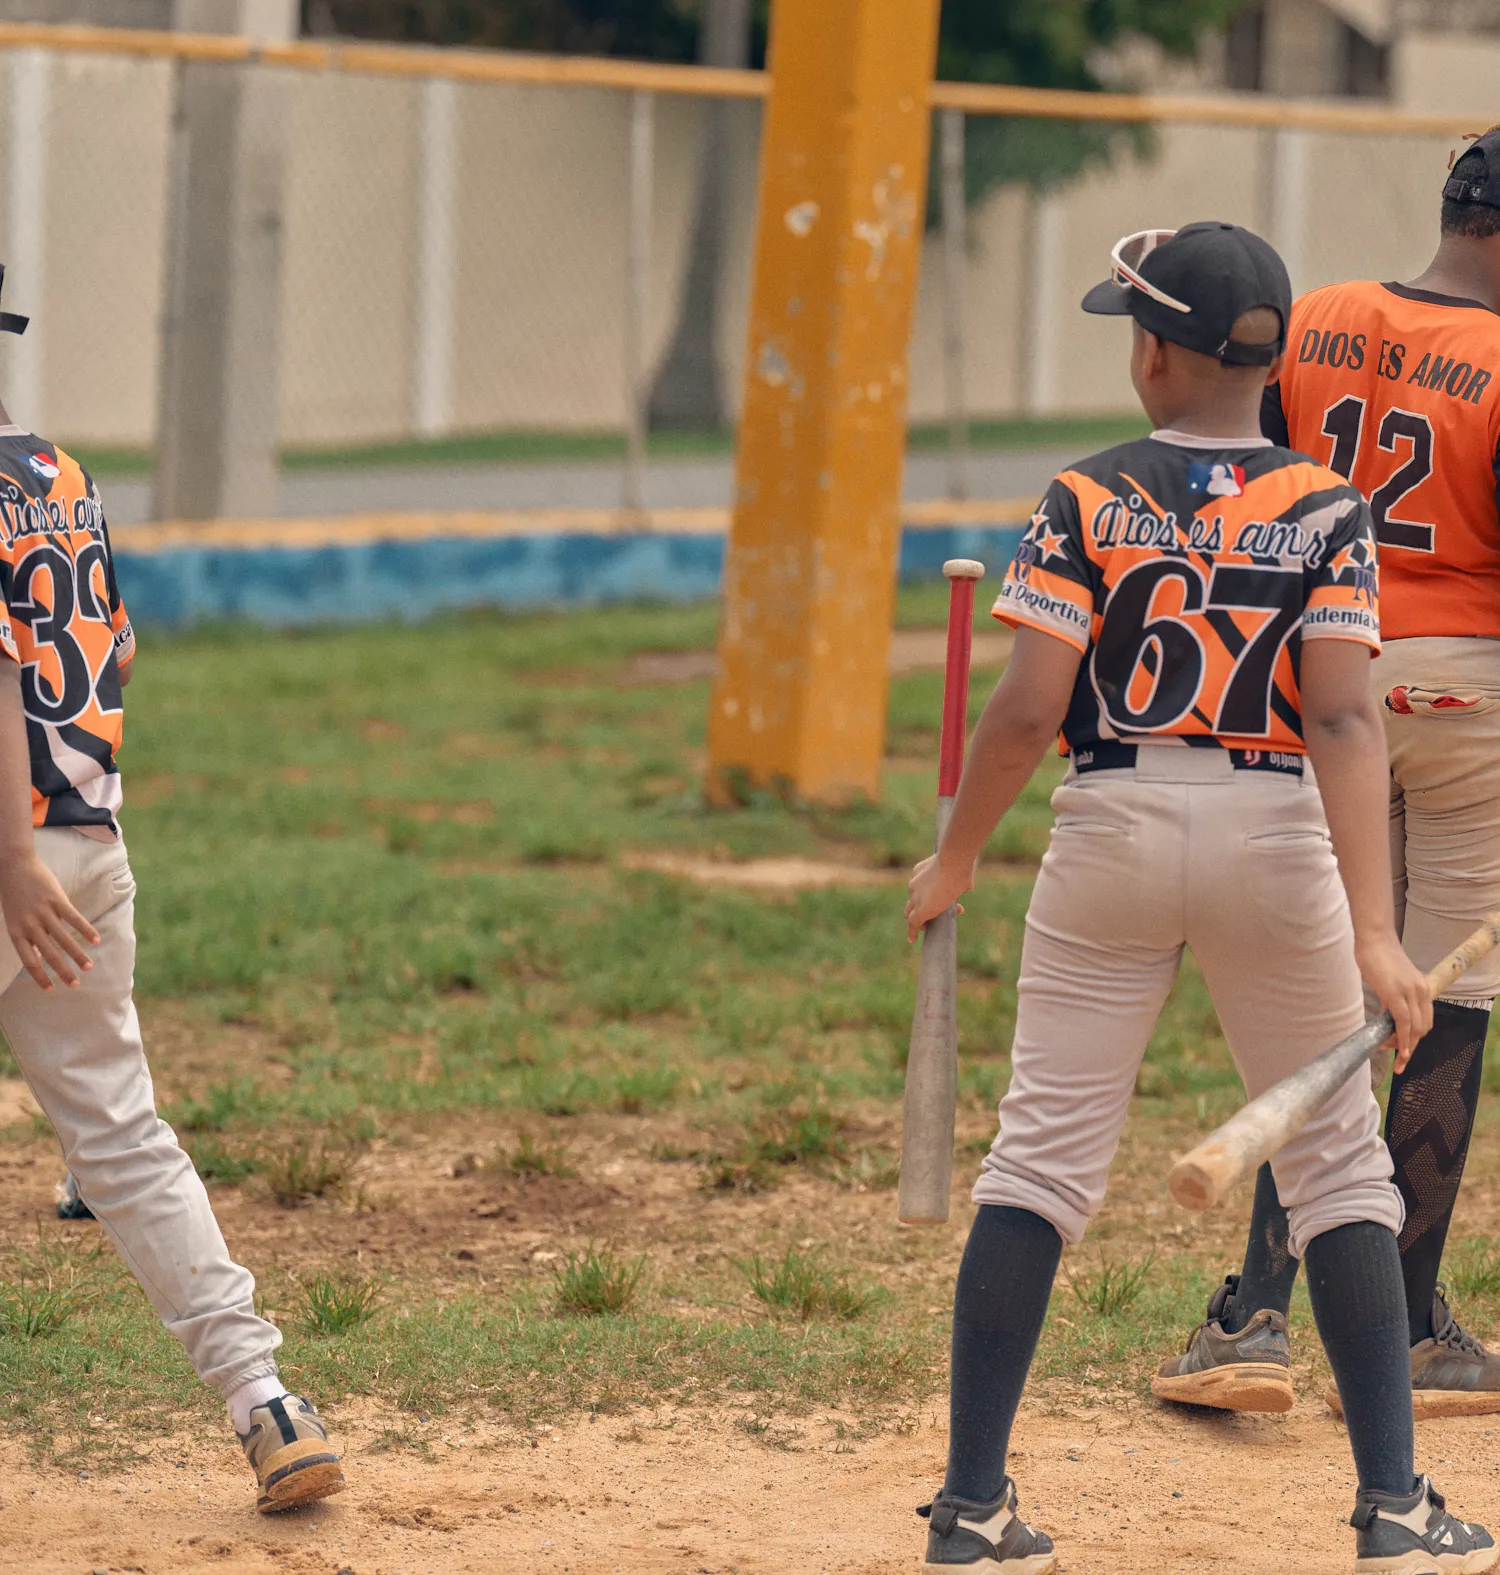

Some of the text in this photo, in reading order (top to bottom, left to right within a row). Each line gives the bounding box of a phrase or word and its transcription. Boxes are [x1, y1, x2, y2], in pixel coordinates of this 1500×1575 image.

[1298, 329, 1492, 405] DIOS ES AMOR
[1090, 493, 1328, 570] Dios es amr
[1320, 393, 1436, 554] 12
[1088, 555, 1304, 738] 67
